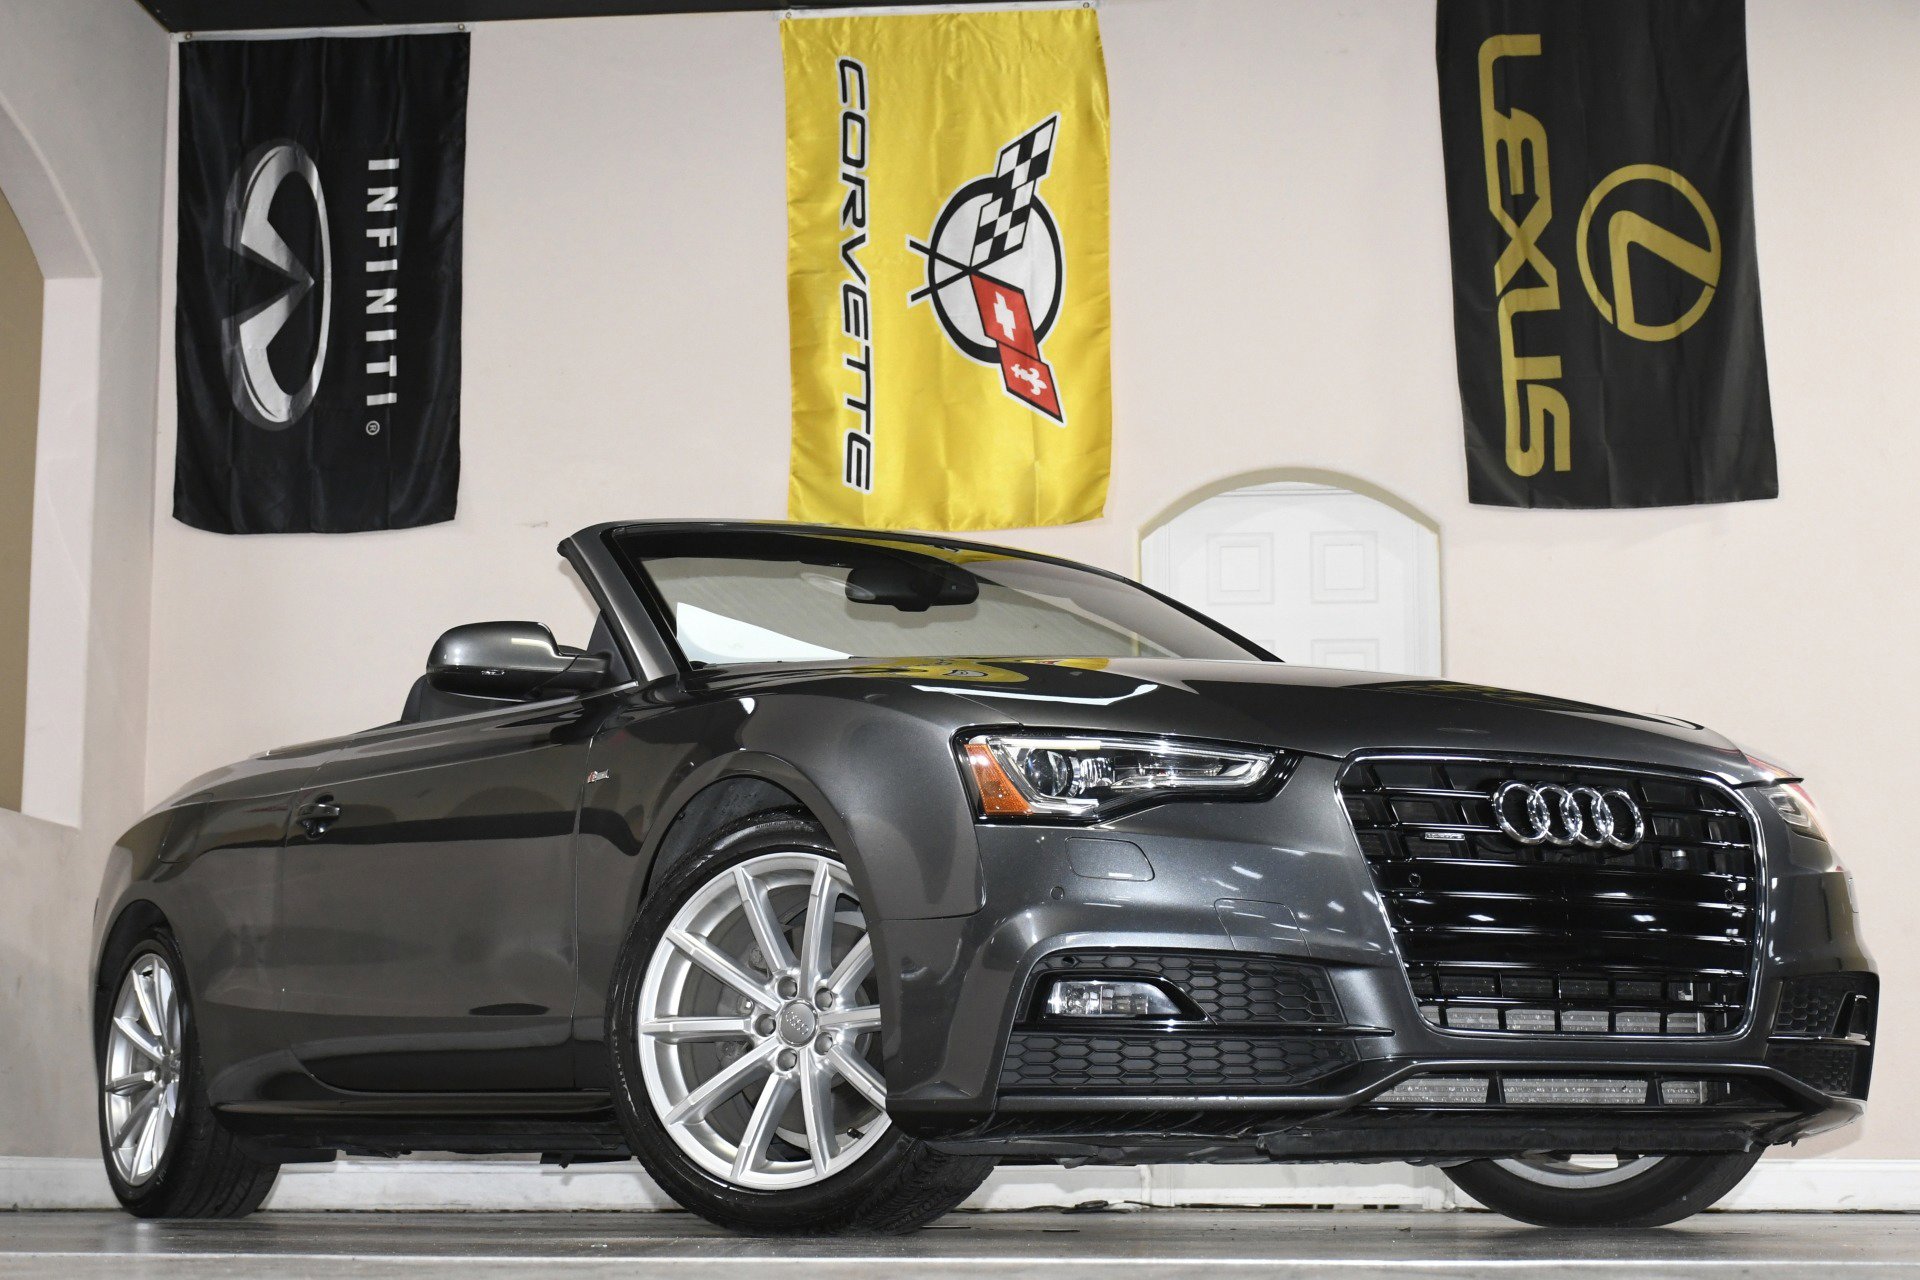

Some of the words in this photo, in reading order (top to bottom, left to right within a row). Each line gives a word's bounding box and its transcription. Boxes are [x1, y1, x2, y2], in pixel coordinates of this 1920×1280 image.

[366, 158, 399, 406] INFINITI
[834, 56, 875, 494] CORVETTE
[1478, 34, 1571, 477] LEXUS
